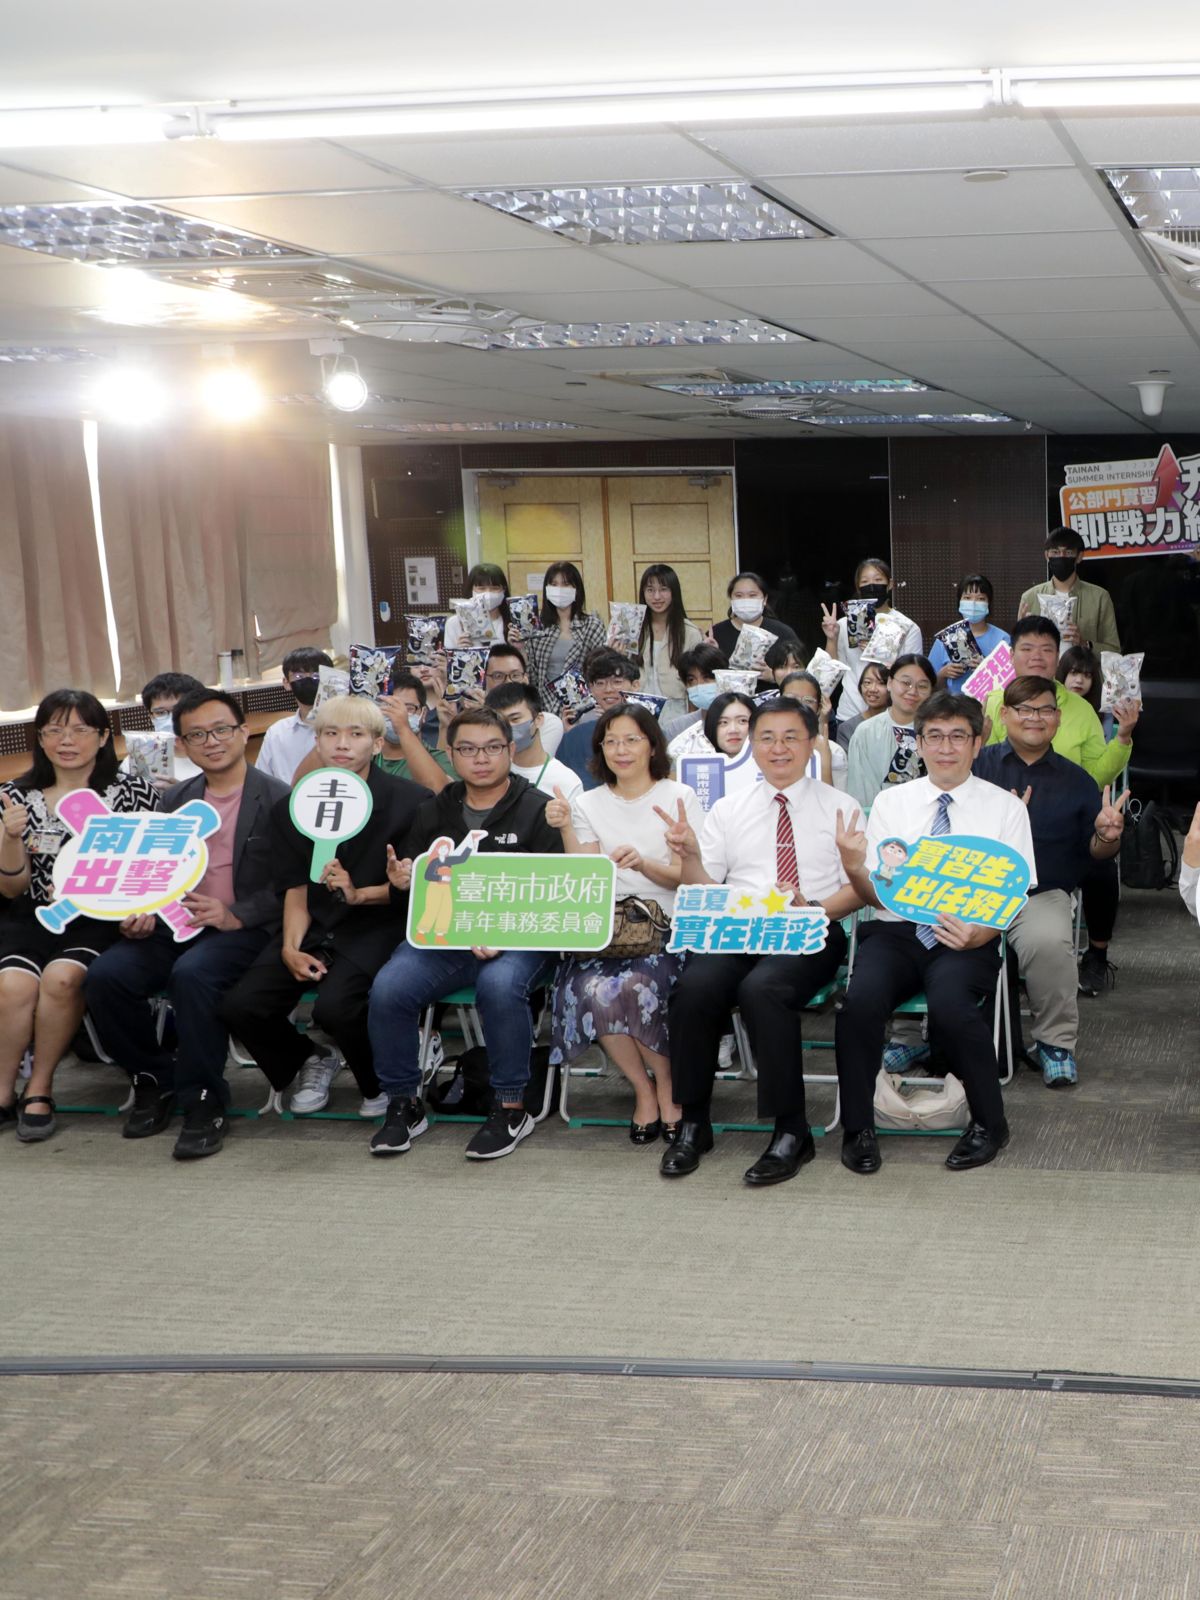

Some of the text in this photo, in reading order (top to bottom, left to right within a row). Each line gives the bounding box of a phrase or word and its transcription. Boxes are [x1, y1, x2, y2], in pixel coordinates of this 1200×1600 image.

[1066, 465, 1100, 475] TAINAN
[1067, 473, 1104, 484] SUMMER
[1069, 486, 1157, 510] 公部門實習
[307, 779, 358, 832] 青
[78, 816, 198, 855] 南青
[61, 858, 179, 896] 出擊
[904, 839, 1017, 888] 實習生
[455, 872, 609, 904] 臺南市政府
[677, 888, 730, 912] 這夏
[454, 910, 604, 934] 青年事務委員會
[671, 915, 826, 951] 實在精彩
